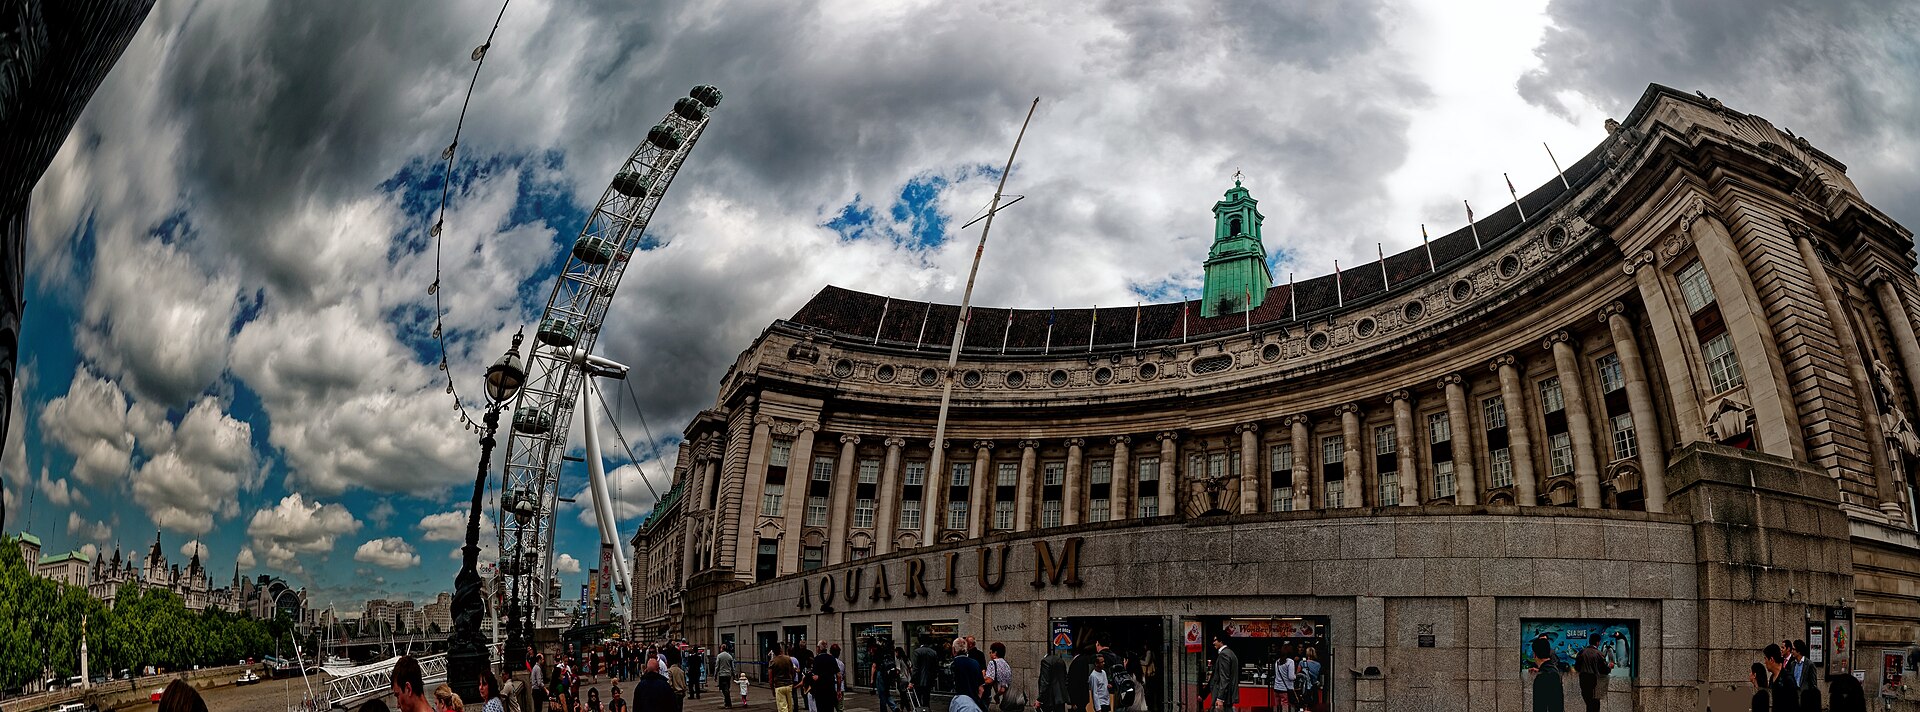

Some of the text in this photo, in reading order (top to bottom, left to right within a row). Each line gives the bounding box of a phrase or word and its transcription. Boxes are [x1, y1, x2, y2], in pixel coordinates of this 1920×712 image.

[1087, 313, 1336, 365] COUNTY HALL
[797, 537, 1083, 612] AQUARIUM
